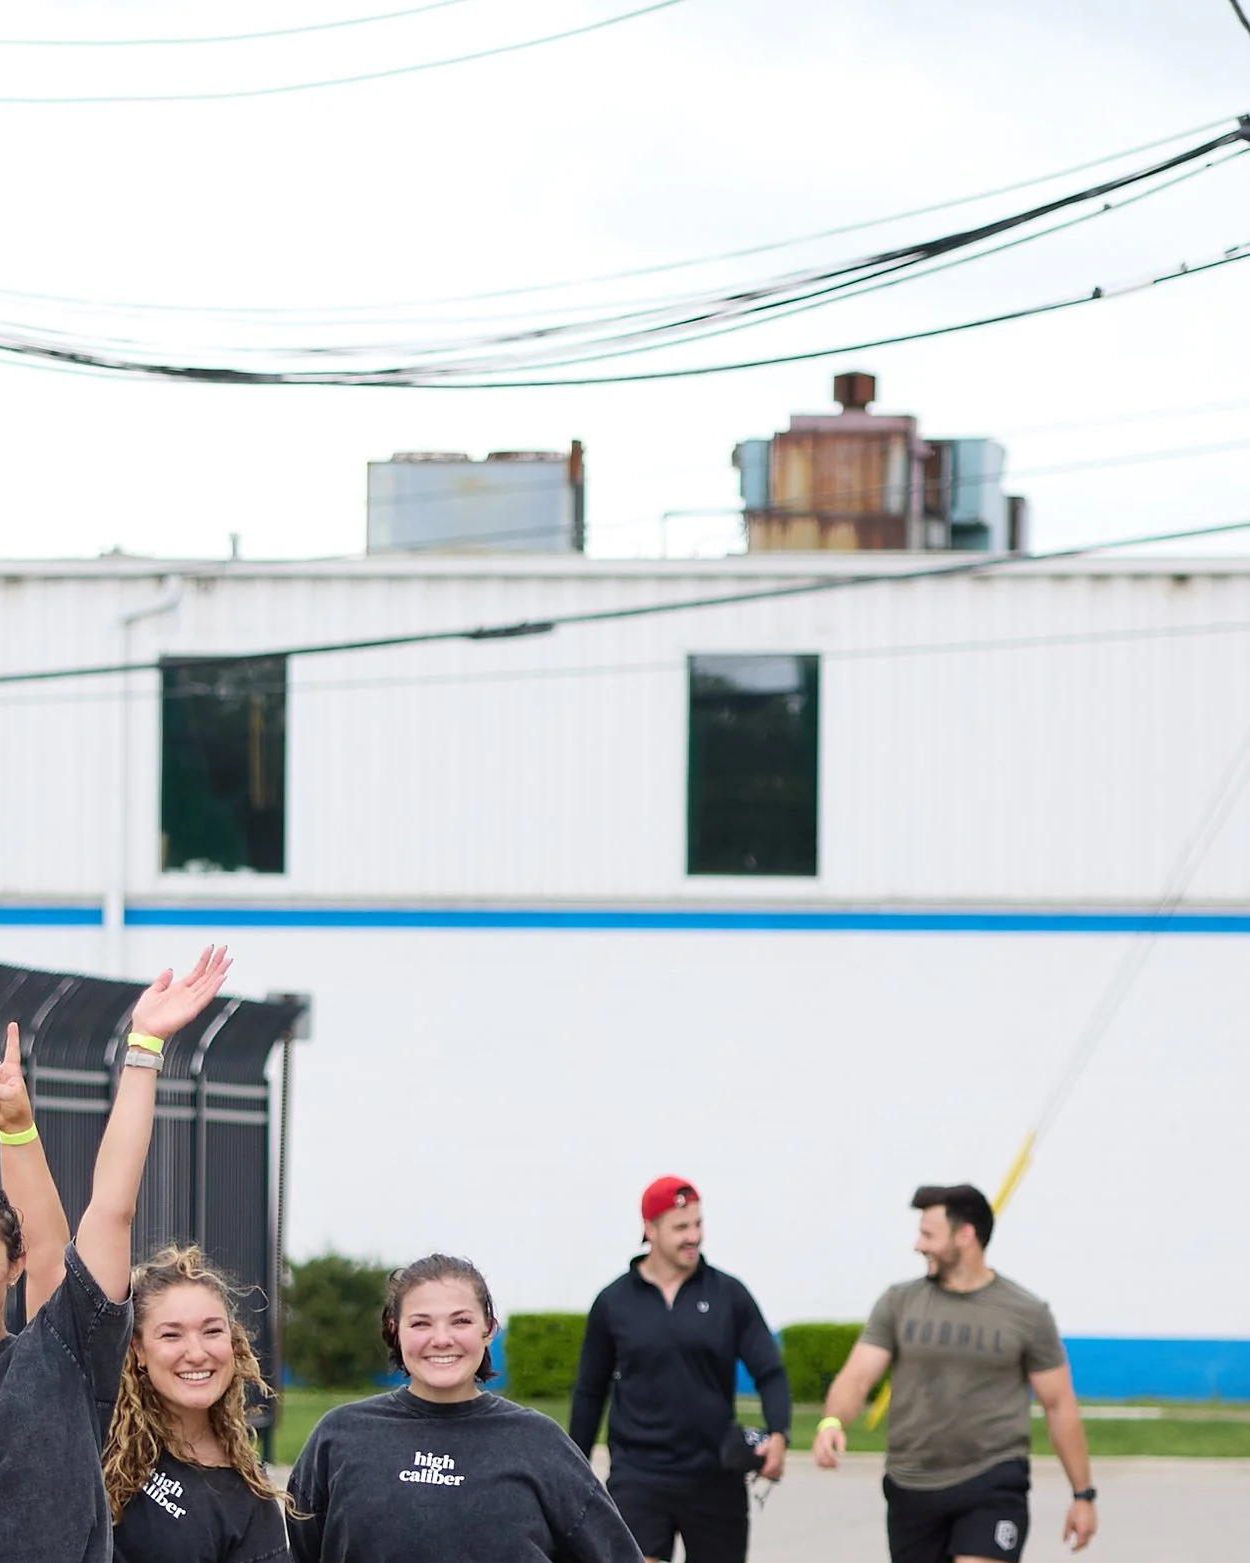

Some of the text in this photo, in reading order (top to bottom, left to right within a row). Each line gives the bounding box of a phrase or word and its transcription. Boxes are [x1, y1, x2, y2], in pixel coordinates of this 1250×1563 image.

[414, 1451, 455, 1471] high
[399, 1468, 465, 1486] caliber
[142, 1482, 187, 1519] liber
